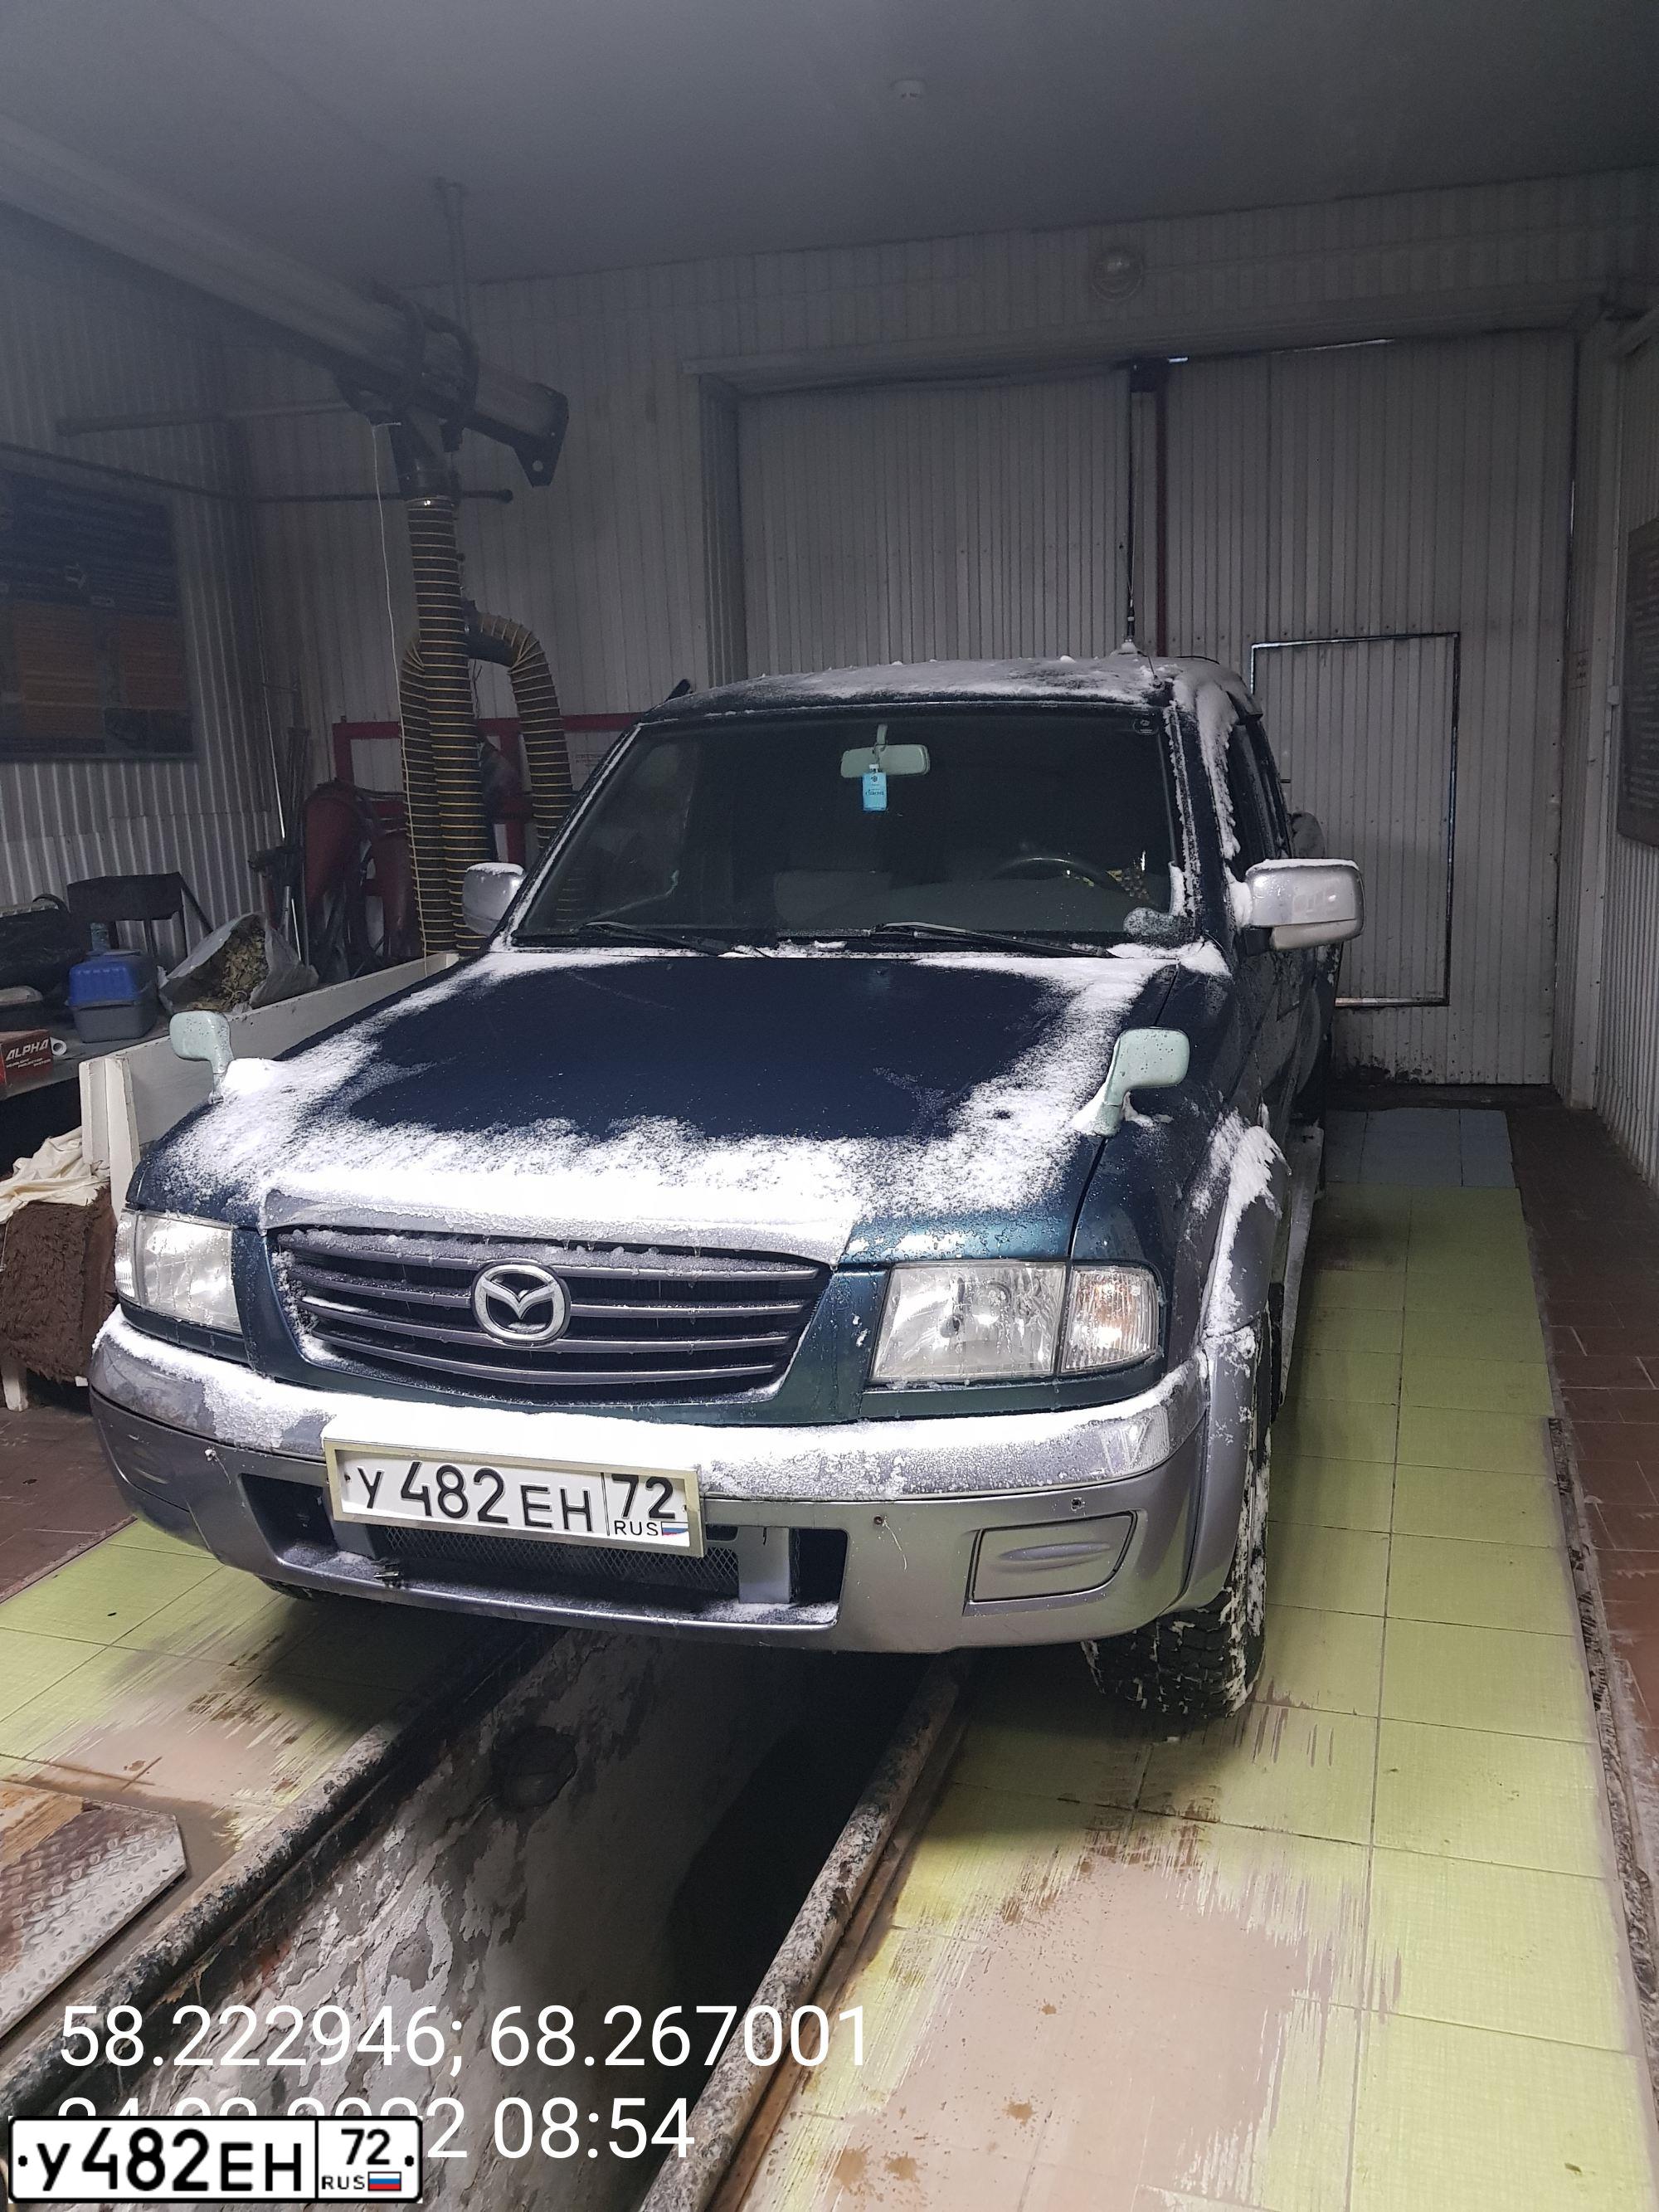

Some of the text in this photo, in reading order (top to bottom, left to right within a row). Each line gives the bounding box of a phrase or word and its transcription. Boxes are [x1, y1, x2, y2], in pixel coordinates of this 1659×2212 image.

[5, 1039, 50, 1061] ALPHA
[611, 1474, 676, 1519] 72
[614, 1520, 659, 1537] RUS
